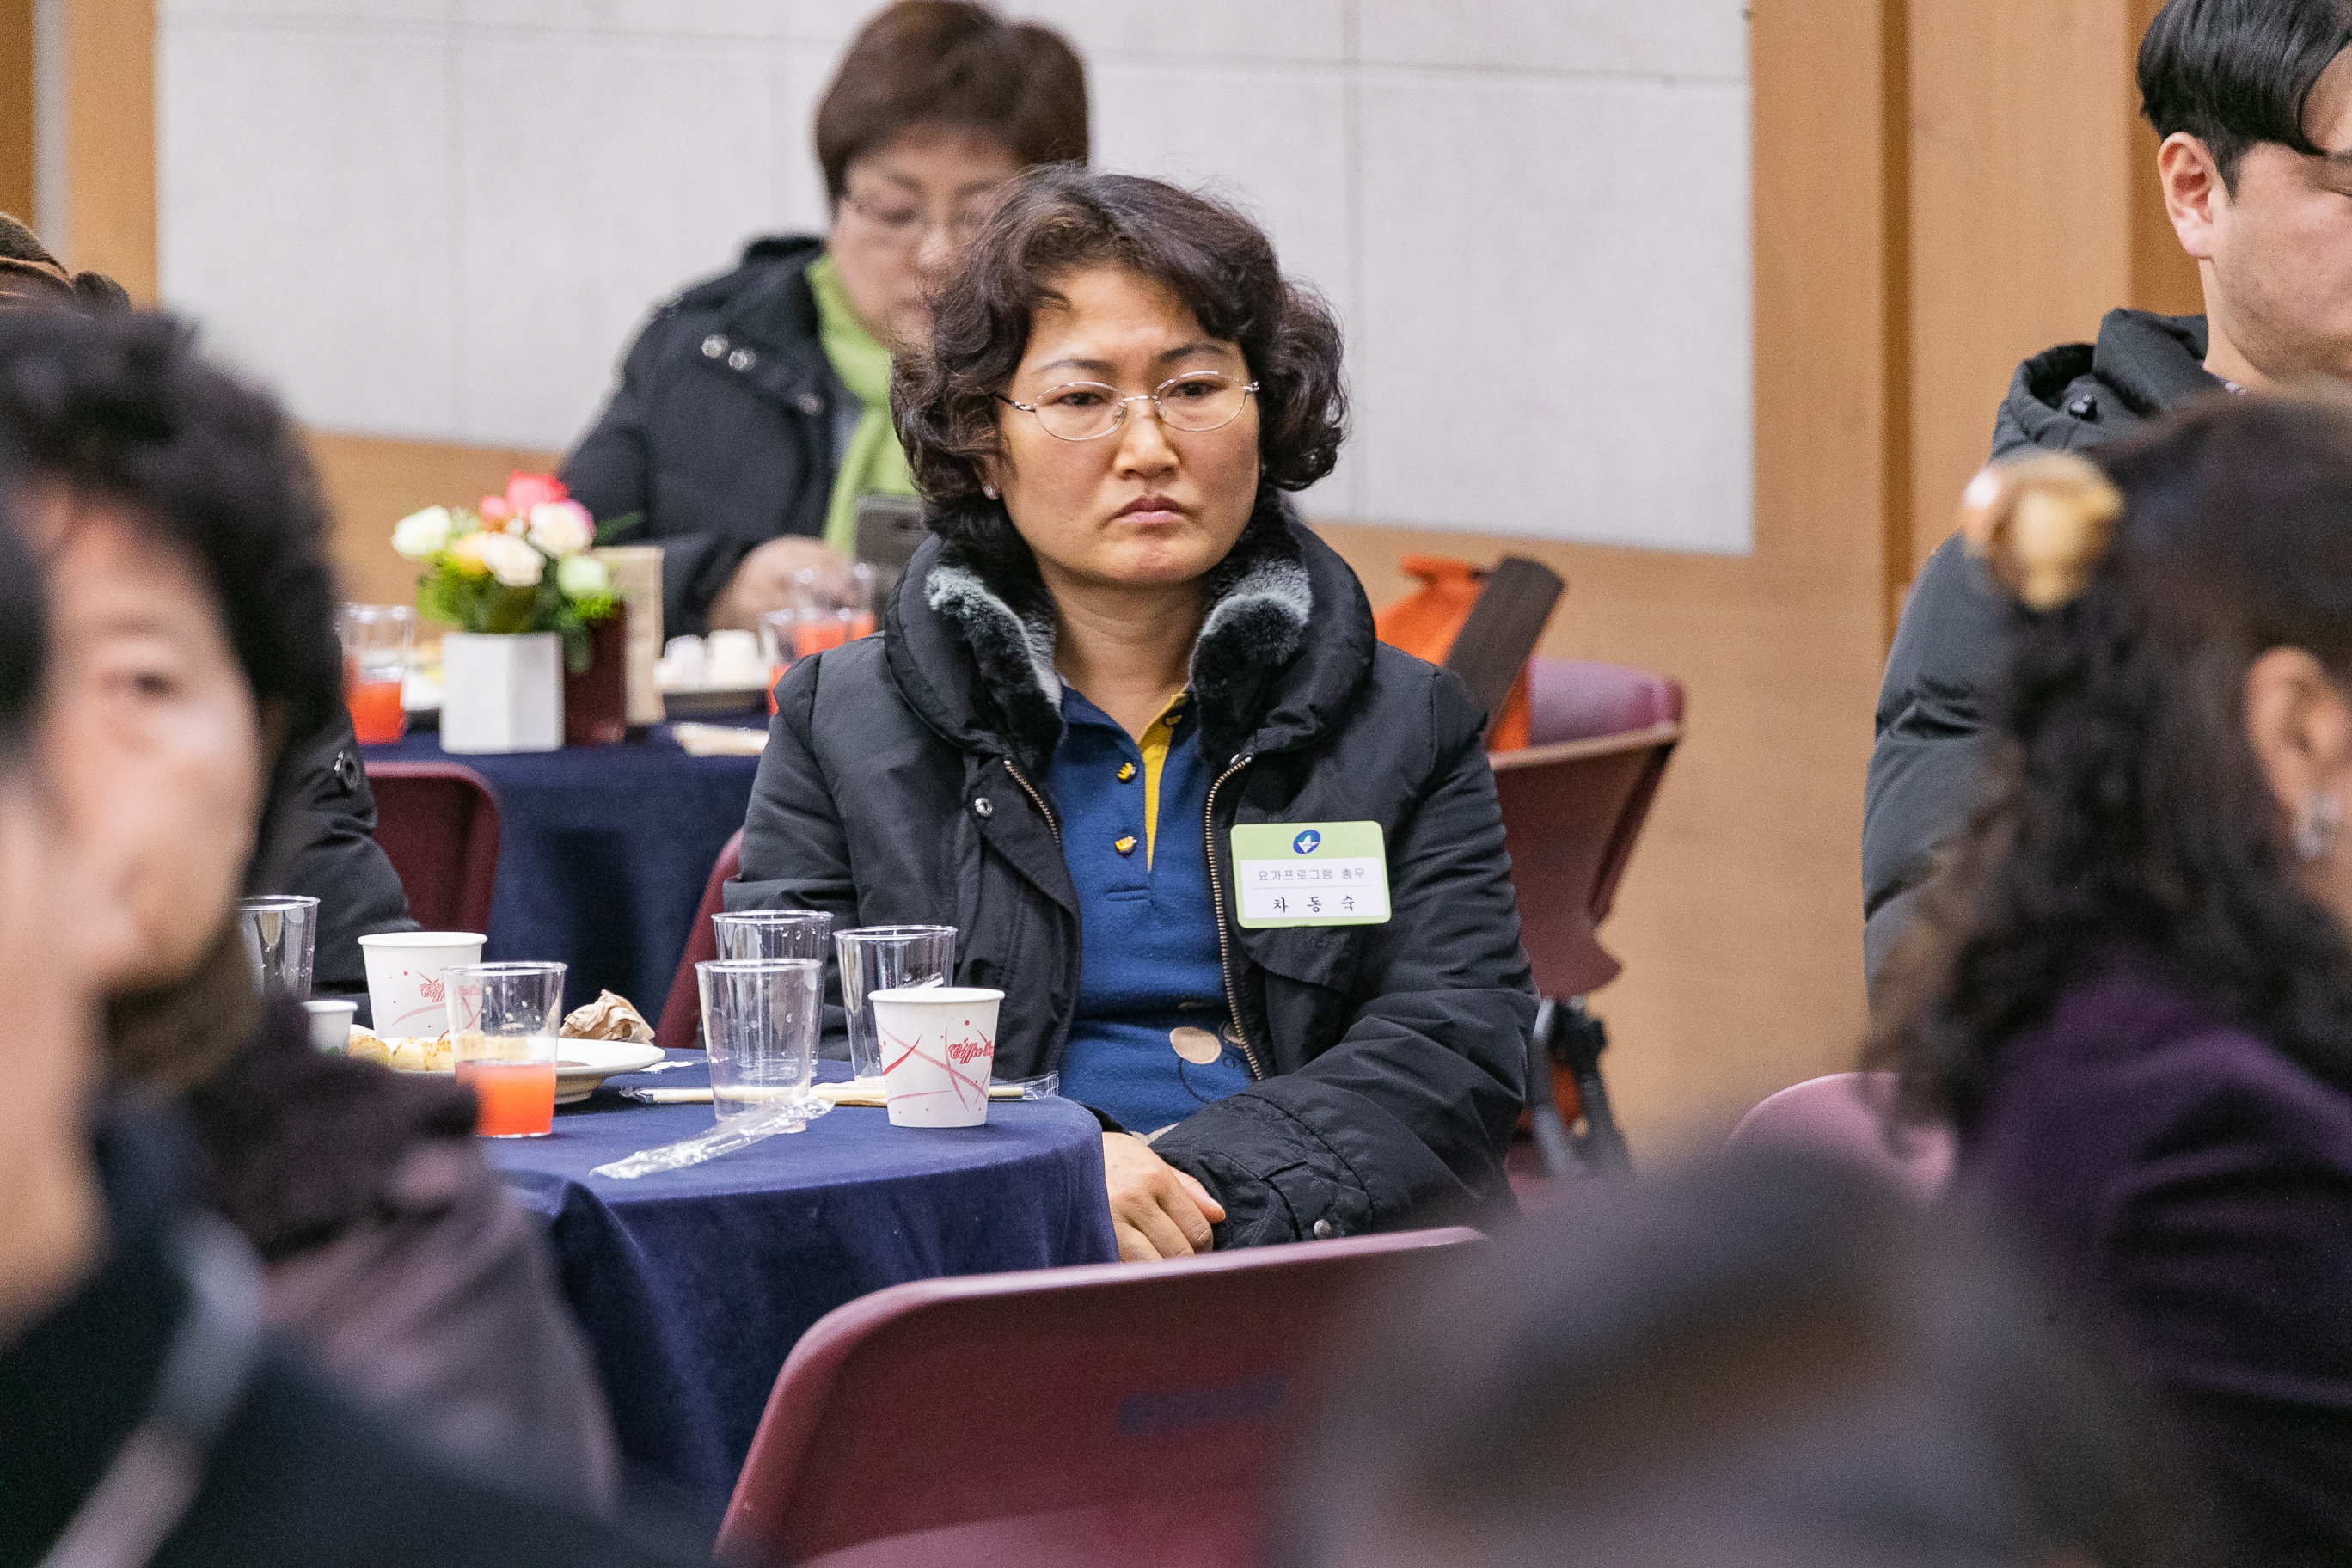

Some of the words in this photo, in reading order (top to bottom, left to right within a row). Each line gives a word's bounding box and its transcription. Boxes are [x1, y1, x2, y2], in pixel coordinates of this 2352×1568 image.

[1258, 868, 1332, 881] 요가프로그램
[1342, 867, 1365, 879] 총무
[948, 1041, 983, 1064] Coffee
